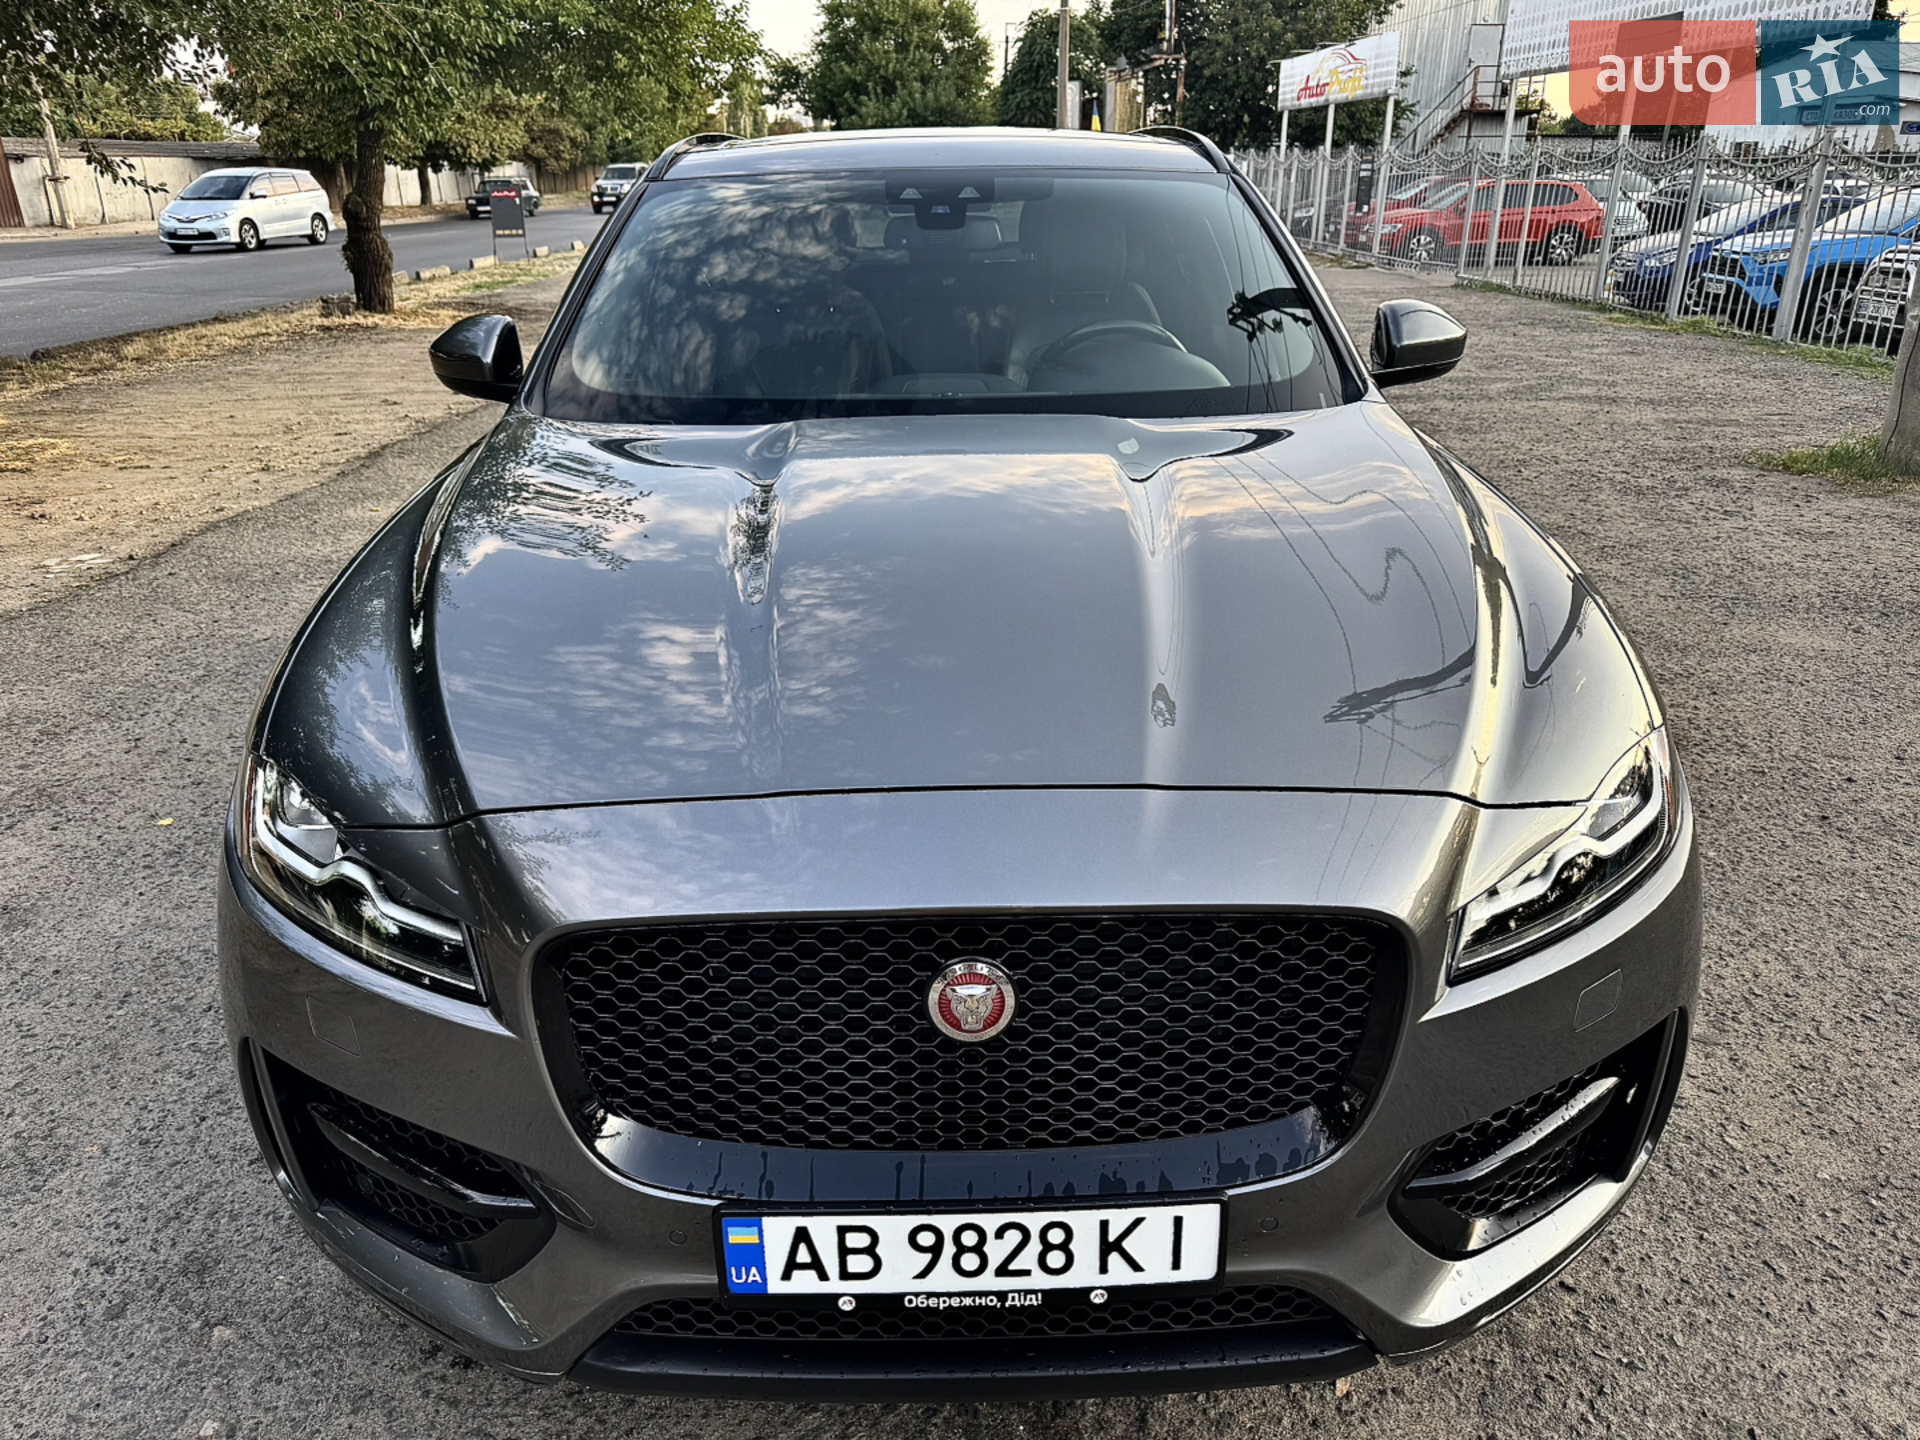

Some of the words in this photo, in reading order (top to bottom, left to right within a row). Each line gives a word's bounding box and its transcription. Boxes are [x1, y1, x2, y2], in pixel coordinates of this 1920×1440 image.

[780, 1224, 883, 1282] AB
[907, 1220, 1075, 1280] 9828
[1099, 1215, 1184, 1275] KI
[731, 1266, 763, 1283] UA
[904, 1295, 1002, 1310] Обережно,
[1005, 1292, 1042, 1308] Дід!
